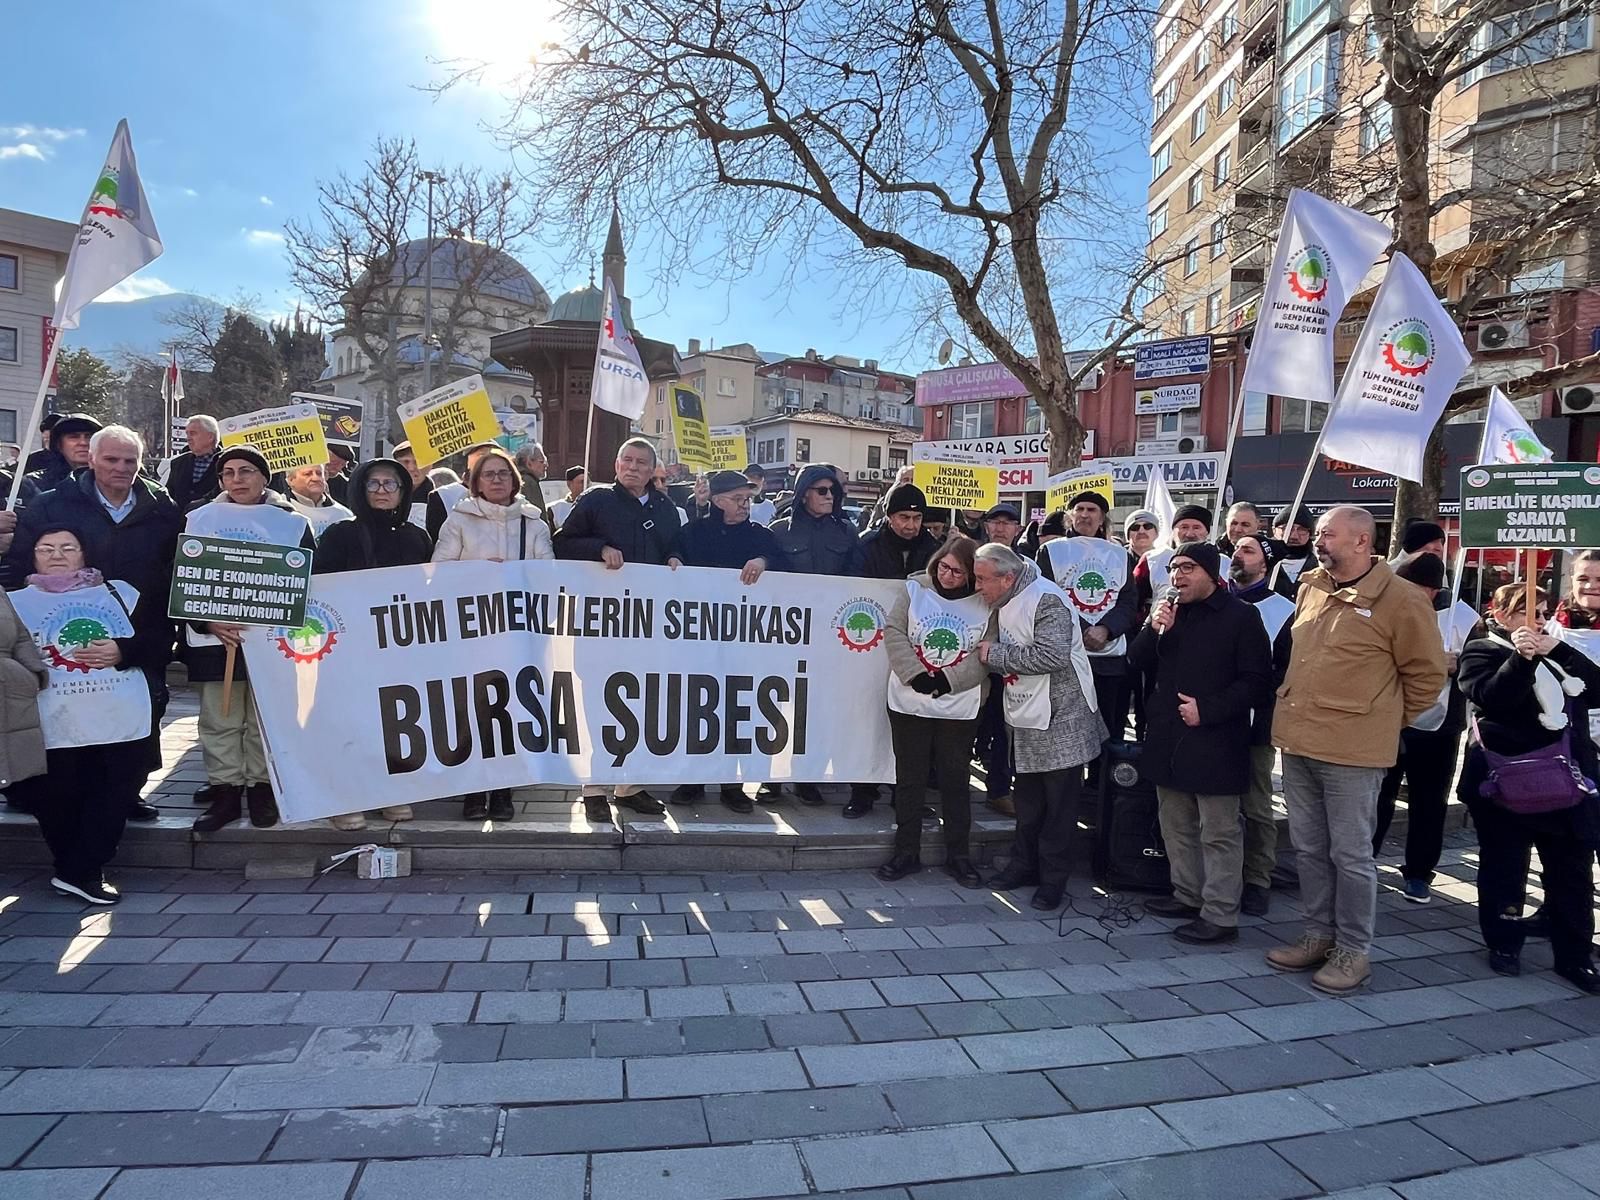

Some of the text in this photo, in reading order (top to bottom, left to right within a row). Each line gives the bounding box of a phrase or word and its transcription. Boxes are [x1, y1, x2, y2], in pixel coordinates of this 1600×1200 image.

[1362, 371, 1381, 379] TÜM
[243, 425, 299, 443] TEMEL GIDA
[263, 447, 296, 461] AMLAR
[938, 465, 974, 478] İNSANCA
[999, 469, 1032, 486] SCH
[1079, 478, 1108, 490] YASASI
[957, 488, 985, 499] ZAMMI
[1465, 493, 1538, 510] EMEKLİYE
[1506, 511, 1567, 525] SARAYA
[1497, 528, 1576, 542] KAZANLA !
[176, 565, 306, 590] BEN DE EKONOMİSTİM
[213, 585, 230, 599] DE
[183, 600, 292, 621] GEÇİNEMİYORUM !
[370, 586, 812, 649] TÜM EMEKLİLERİN SENDİKASI
[378, 659, 808, 775] BURSA ŞUBESİ
